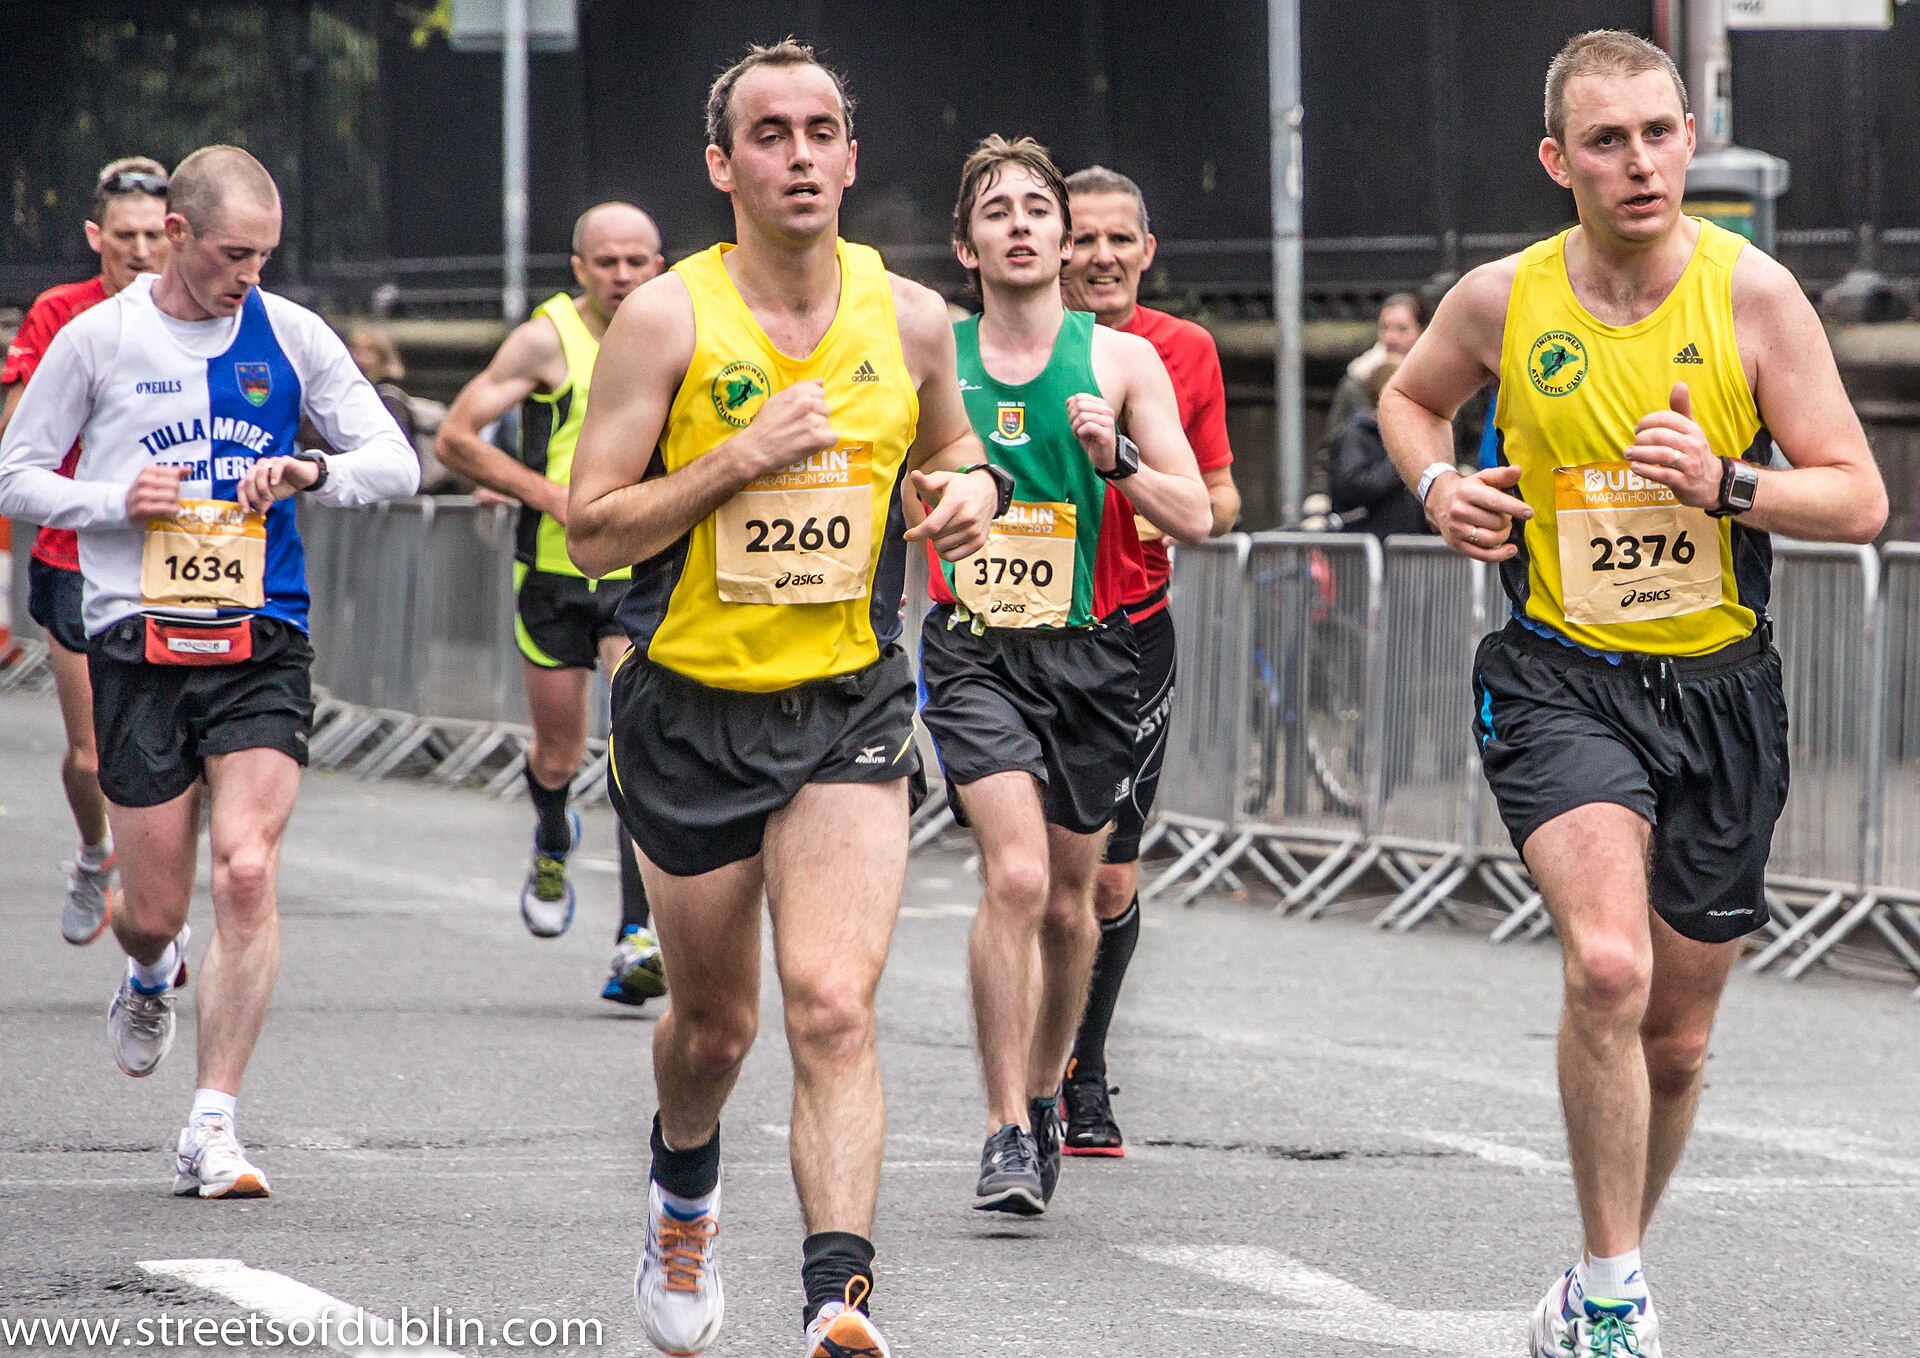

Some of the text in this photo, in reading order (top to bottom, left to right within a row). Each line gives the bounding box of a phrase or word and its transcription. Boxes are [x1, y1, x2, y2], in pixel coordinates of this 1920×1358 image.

[1536, 333, 1581, 351] INISHOWEN
[1673, 355, 1704, 364] adidas
[722, 364, 765, 384] INISHOWEN
[851, 373, 880, 382] adidas
[1531, 368, 1584, 393] ATHLETIC CLUB
[136, 380, 182, 394] O'NEILLS
[715, 395, 747, 425] ATHLETIC
[818, 472, 848, 484] 2012
[1586, 490, 1674, 504] MARATHON 20
[745, 515, 851, 553] 2260
[1590, 530, 1696, 572] 2376
[165, 555, 244, 584] 1634
[973, 558, 1053, 587] 3790
